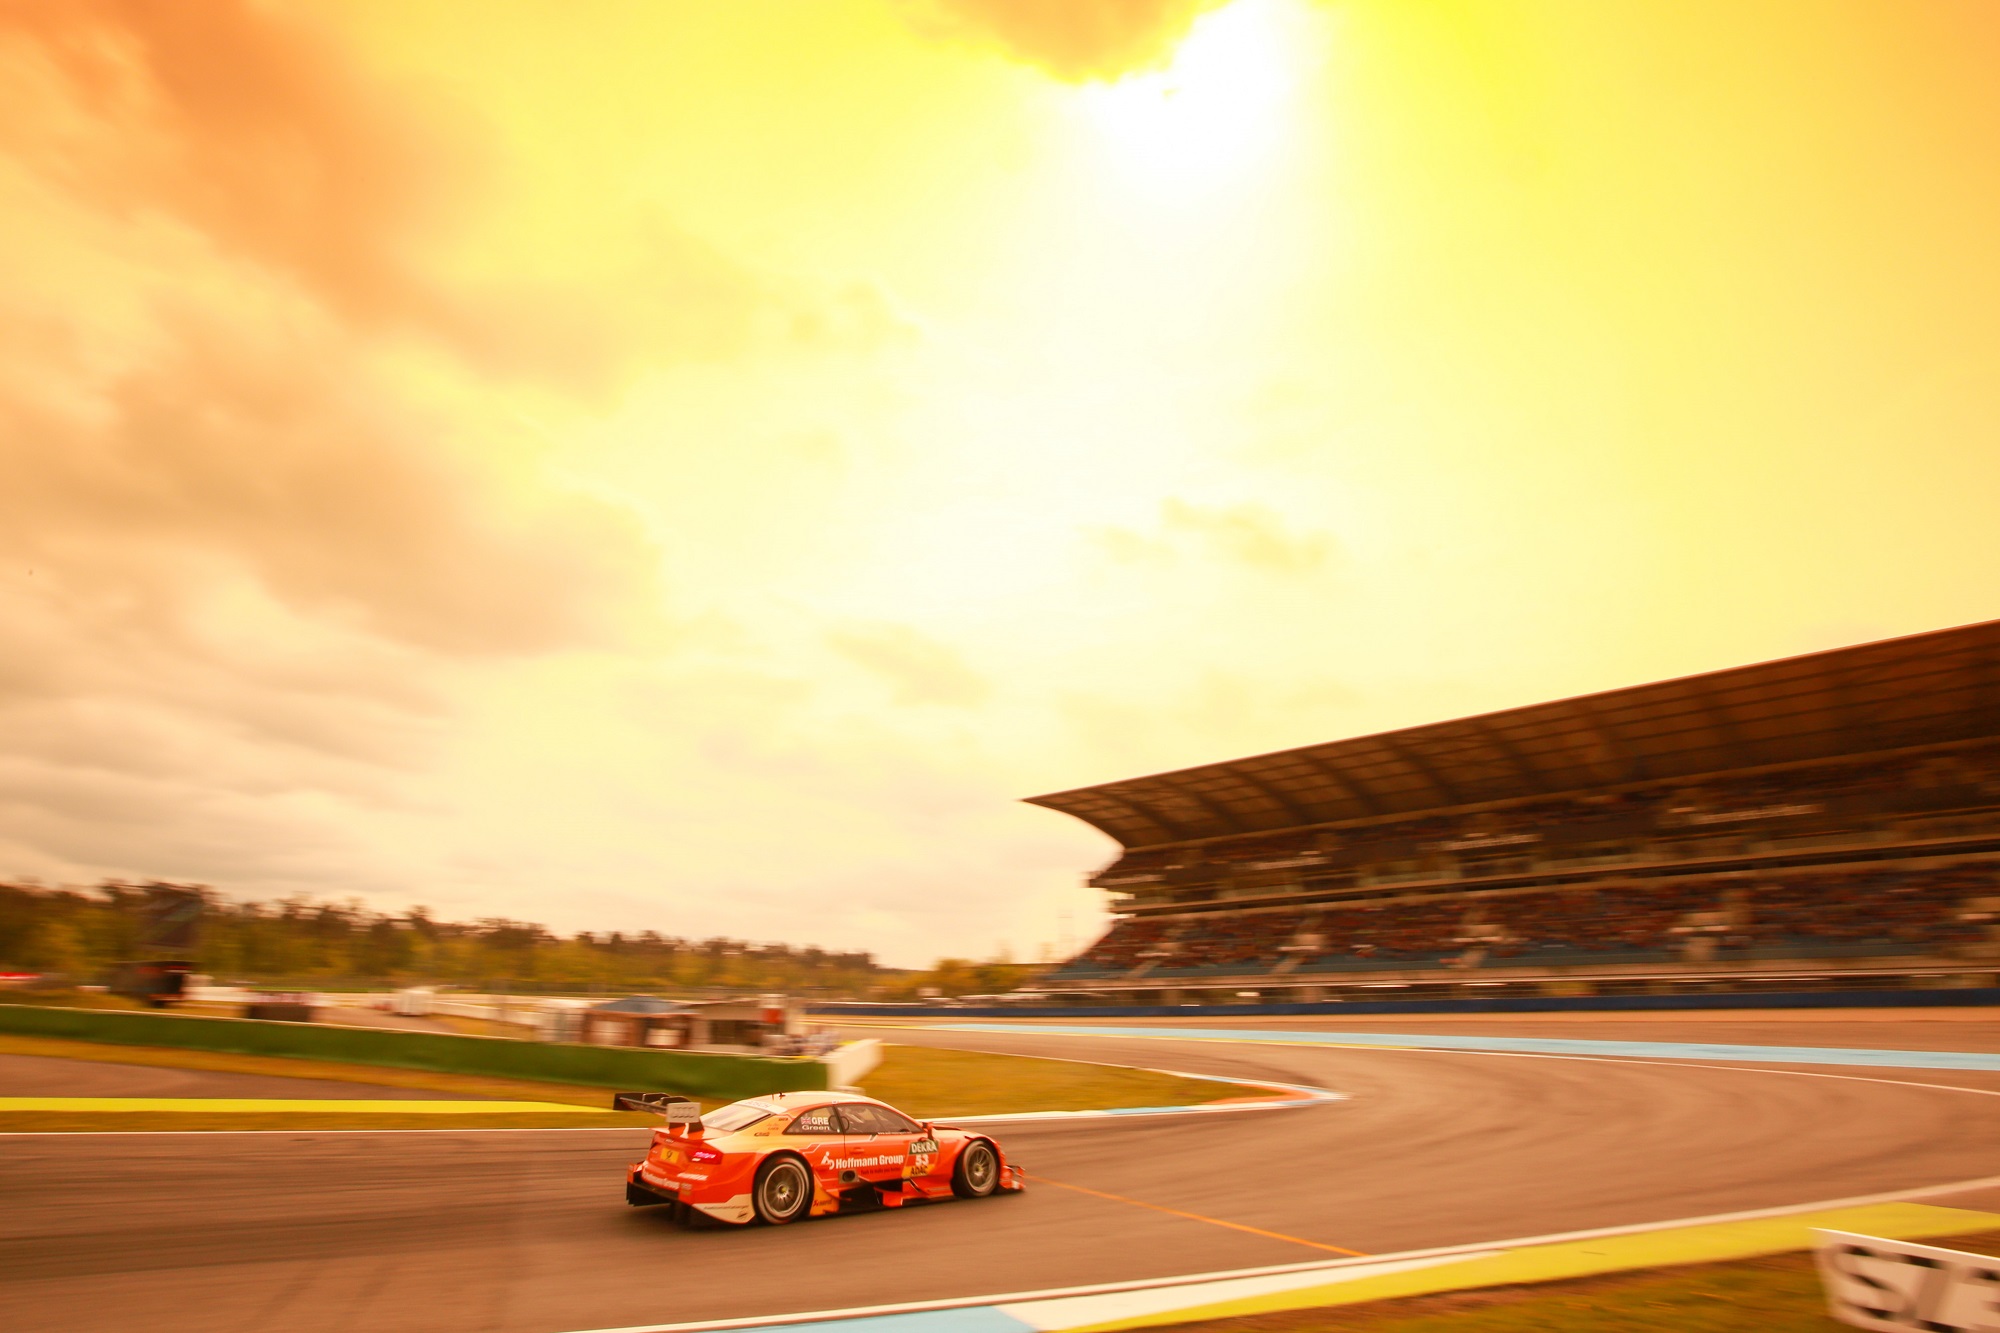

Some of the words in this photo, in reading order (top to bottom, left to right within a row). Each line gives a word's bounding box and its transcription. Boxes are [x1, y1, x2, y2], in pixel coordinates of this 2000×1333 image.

[811, 1116, 829, 1125] GRE
[911, 1141, 937, 1153] DEKRA
[835, 1157, 878, 1169] Hoffmann
[879, 1154, 904, 1165] Group
[915, 1154, 929, 1167] 53
